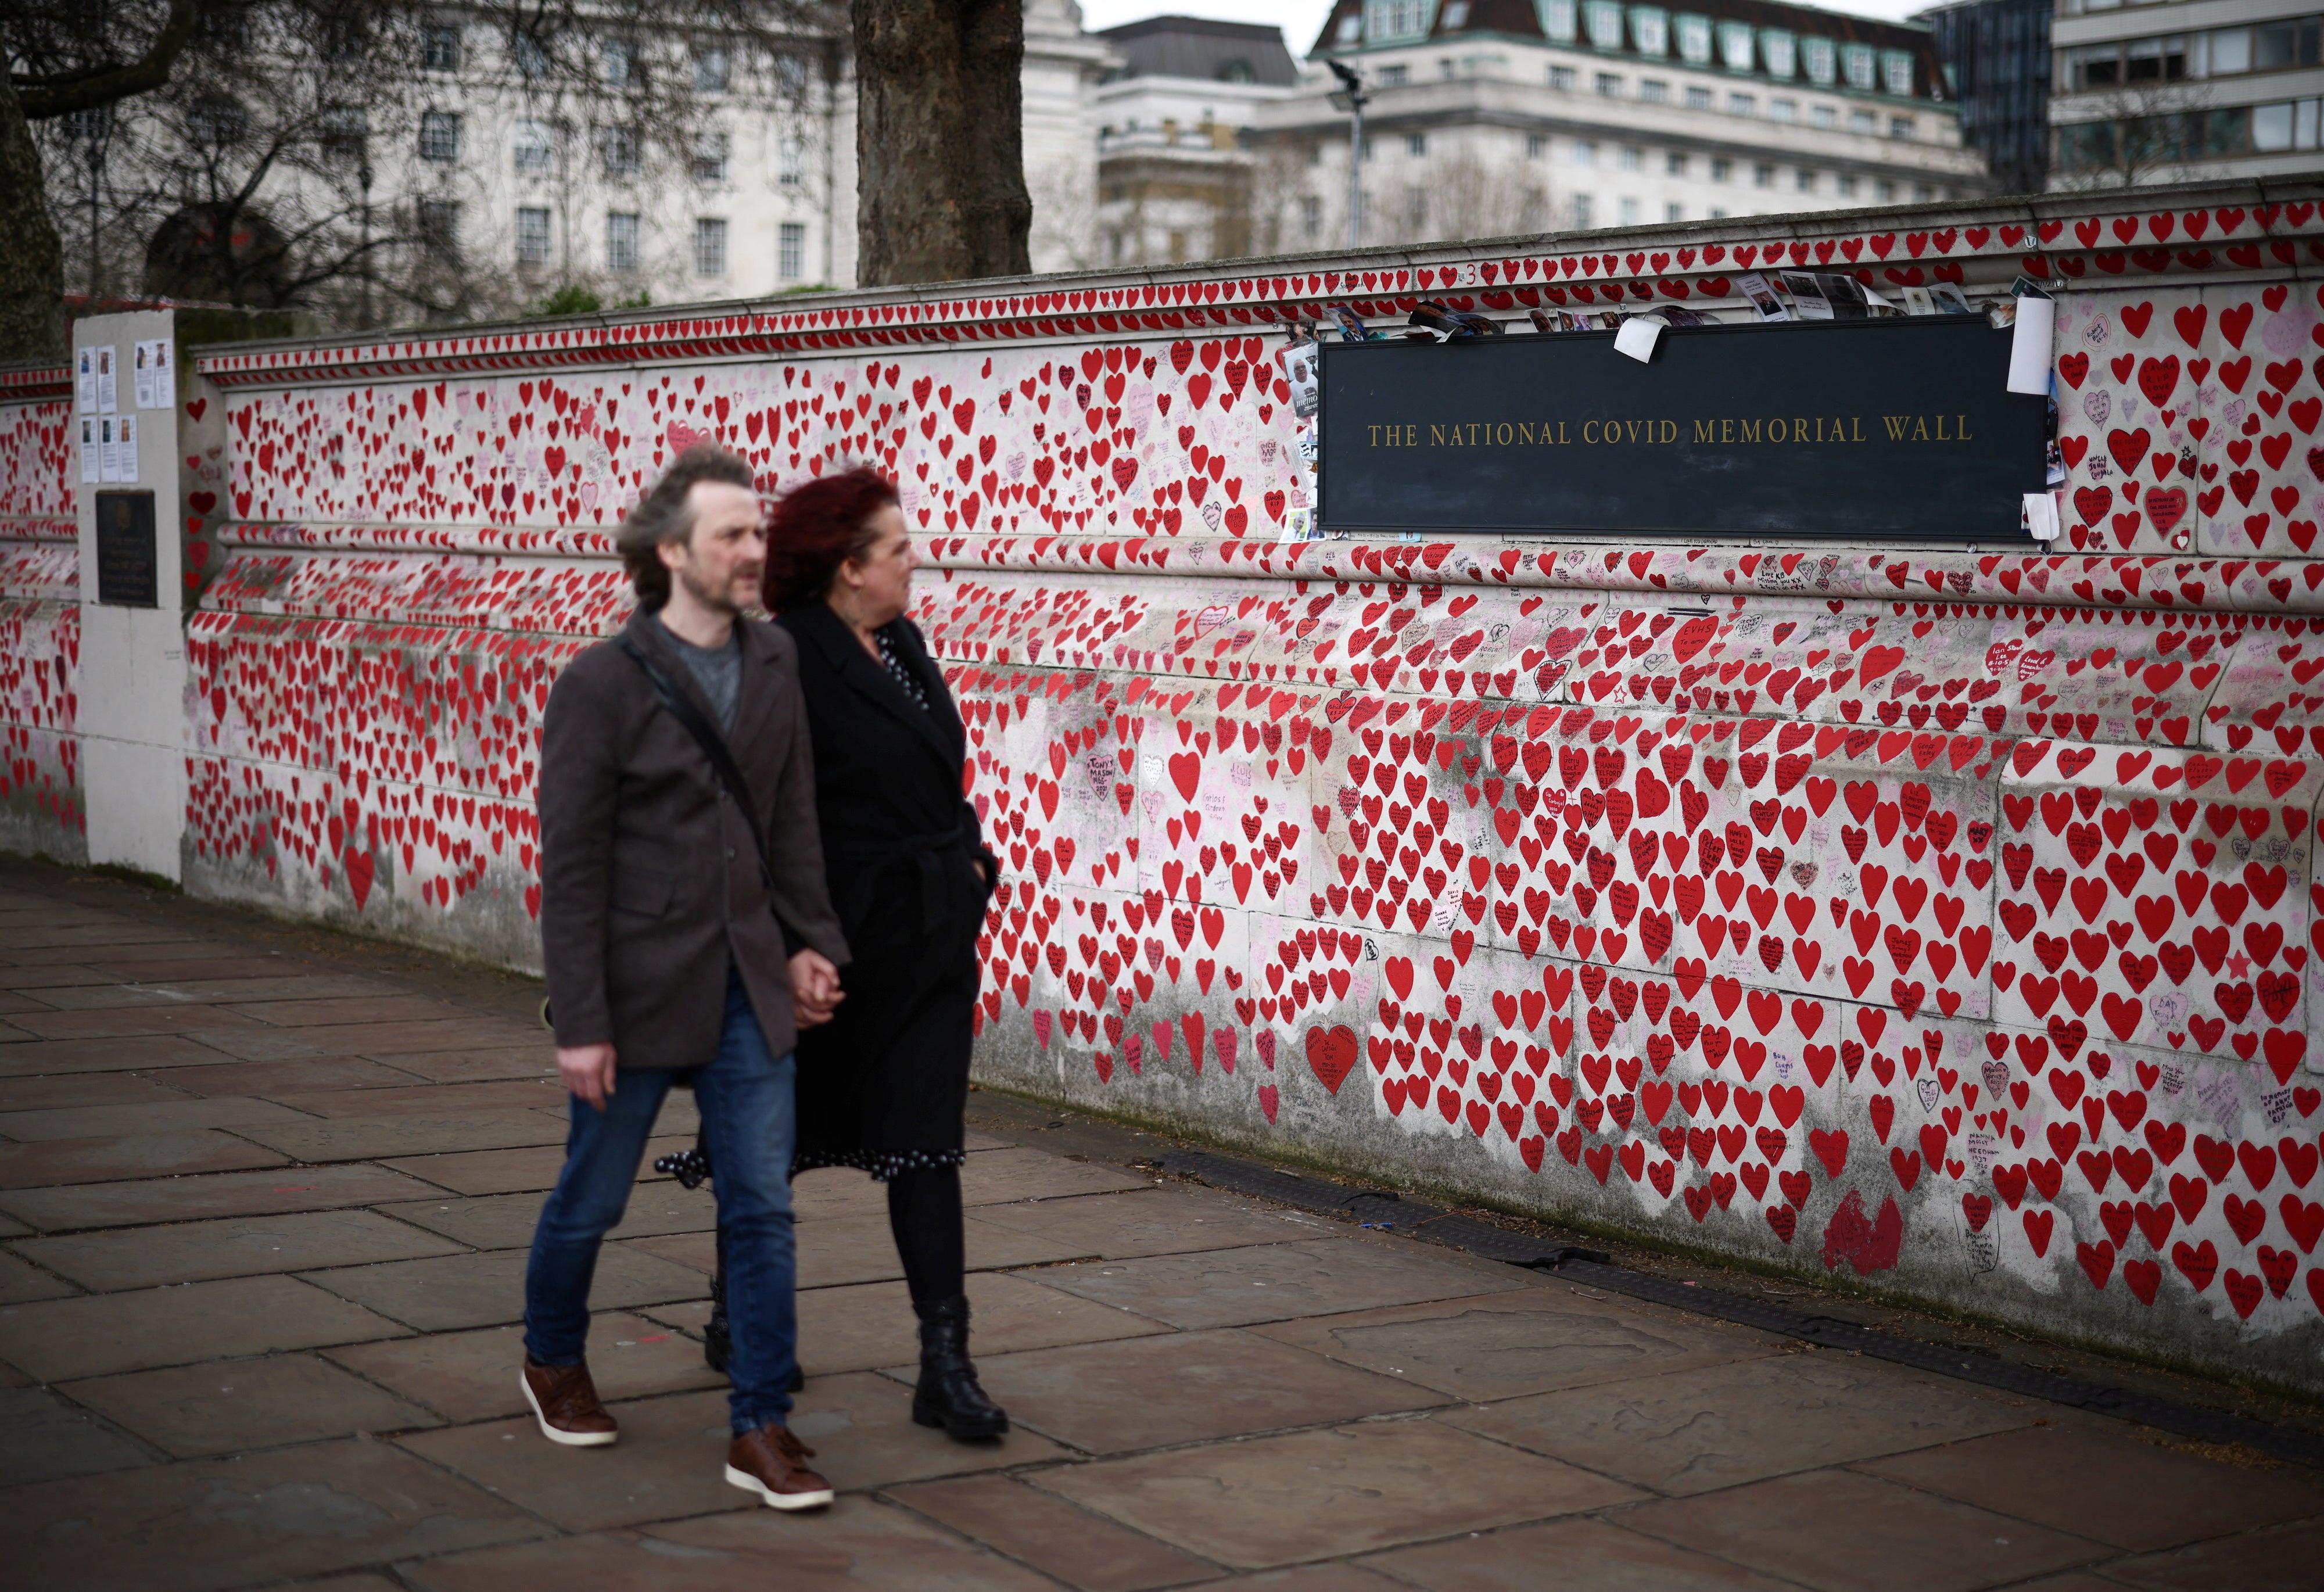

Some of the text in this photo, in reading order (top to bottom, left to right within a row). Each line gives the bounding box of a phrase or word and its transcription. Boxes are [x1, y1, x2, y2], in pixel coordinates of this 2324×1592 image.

[1466, 264, 1476, 285] 3
[2087, 324, 2100, 338] Robert
[2143, 363, 2175, 372] LAURA
[1368, 415, 1973, 447] THE NATIONAL COVID MEMORIAL WALL
[1630, 557, 1648, 566] GWJ
[1684, 624, 1712, 635] EVHS
[1848, 734, 1864, 744] MISS
[1090, 758, 1110, 769] TONY
[1563, 755, 1579, 764] Gerry
[1090, 769, 1113, 777] MASON
[1597, 769, 1621, 778] TELFORD
[1702, 835, 1722, 852] Peter
[1549, 867, 1560, 876] LOVE
[1614, 884, 1631, 894] Samson
[1619, 993, 1633, 1002] miss
[1591, 1007, 1604, 1019] Dear
[1338, 1028, 1350, 1036] NEVER
[2052, 1024, 2070, 1034] Nanny
[1308, 1038, 1321, 1052] FOREVER
[1440, 1098, 1457, 1107] Sam
[1969, 1132, 1995, 1141] NANNA
[2181, 1252, 2208, 1263] PEGGY
[2181, 1263, 2217, 1275] GOSHAWK
[2230, 1281, 2261, 1293] MARION
[2232, 1291, 2255, 1301] PRICE
